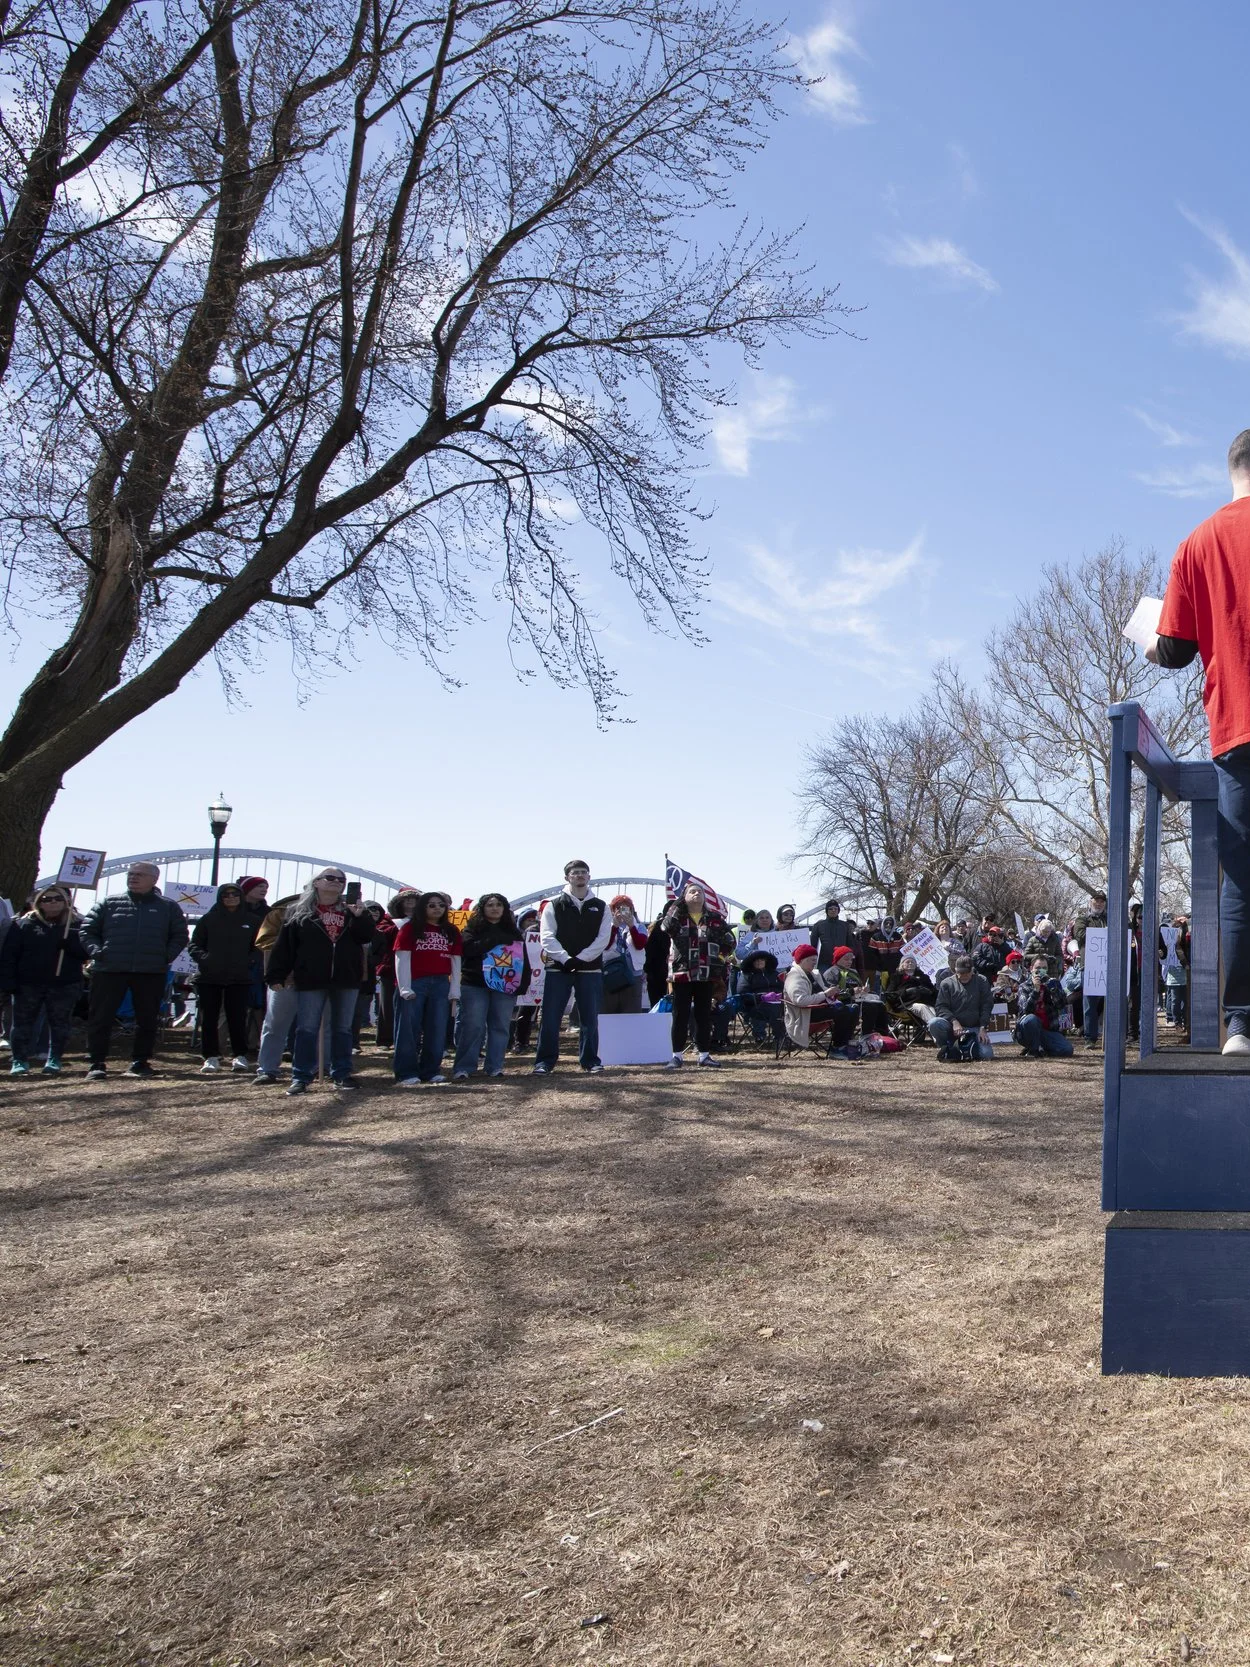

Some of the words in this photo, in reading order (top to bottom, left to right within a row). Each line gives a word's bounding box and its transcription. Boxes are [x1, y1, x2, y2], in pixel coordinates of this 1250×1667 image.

[175, 884, 187, 892] NO
[1089, 936, 1108, 952] ST
[1088, 970, 1107, 988] HA
